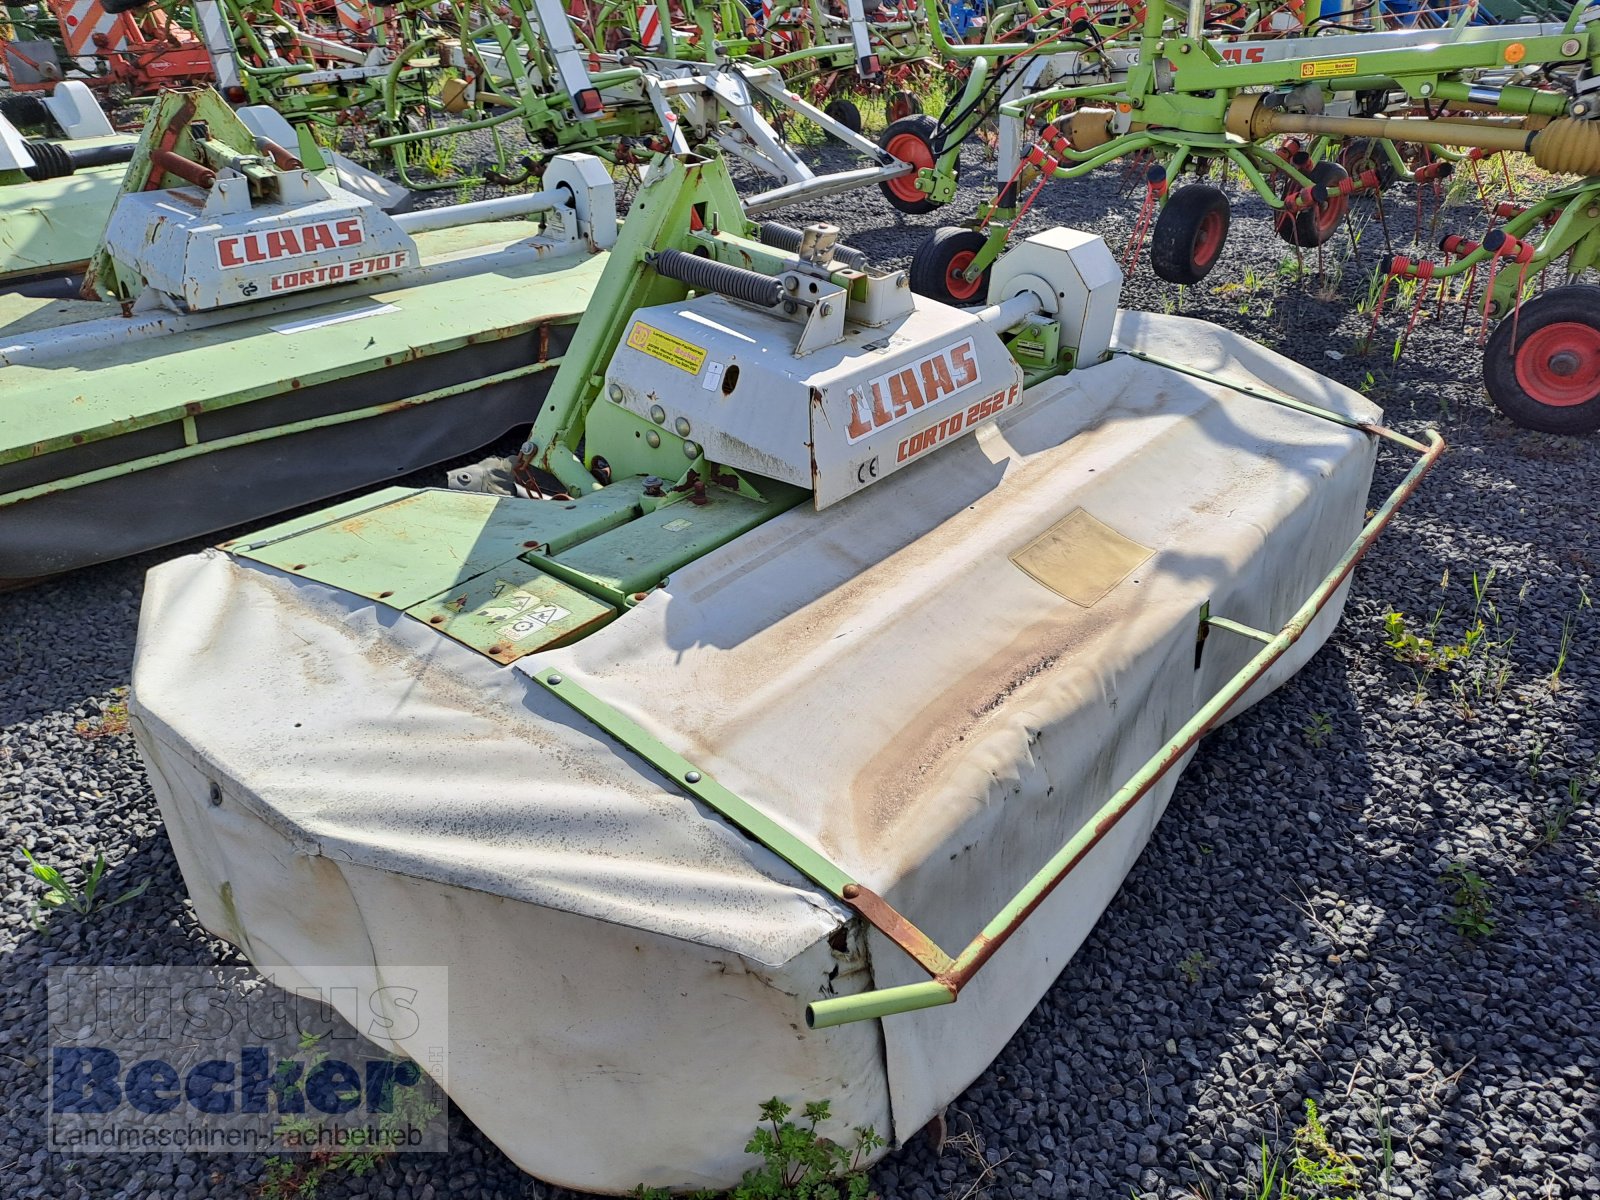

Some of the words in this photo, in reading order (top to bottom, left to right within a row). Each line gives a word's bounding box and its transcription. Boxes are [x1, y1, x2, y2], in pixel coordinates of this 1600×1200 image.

[217, 219, 363, 268] CLAAS
[271, 265, 344, 291] CORTO
[349, 256, 390, 276] 270
[395, 253, 406, 268] F
[897, 412, 964, 463] CORTO
[966, 392, 1006, 427] 252
[1007, 383, 1019, 405] F
[857, 457, 877, 484] CE
